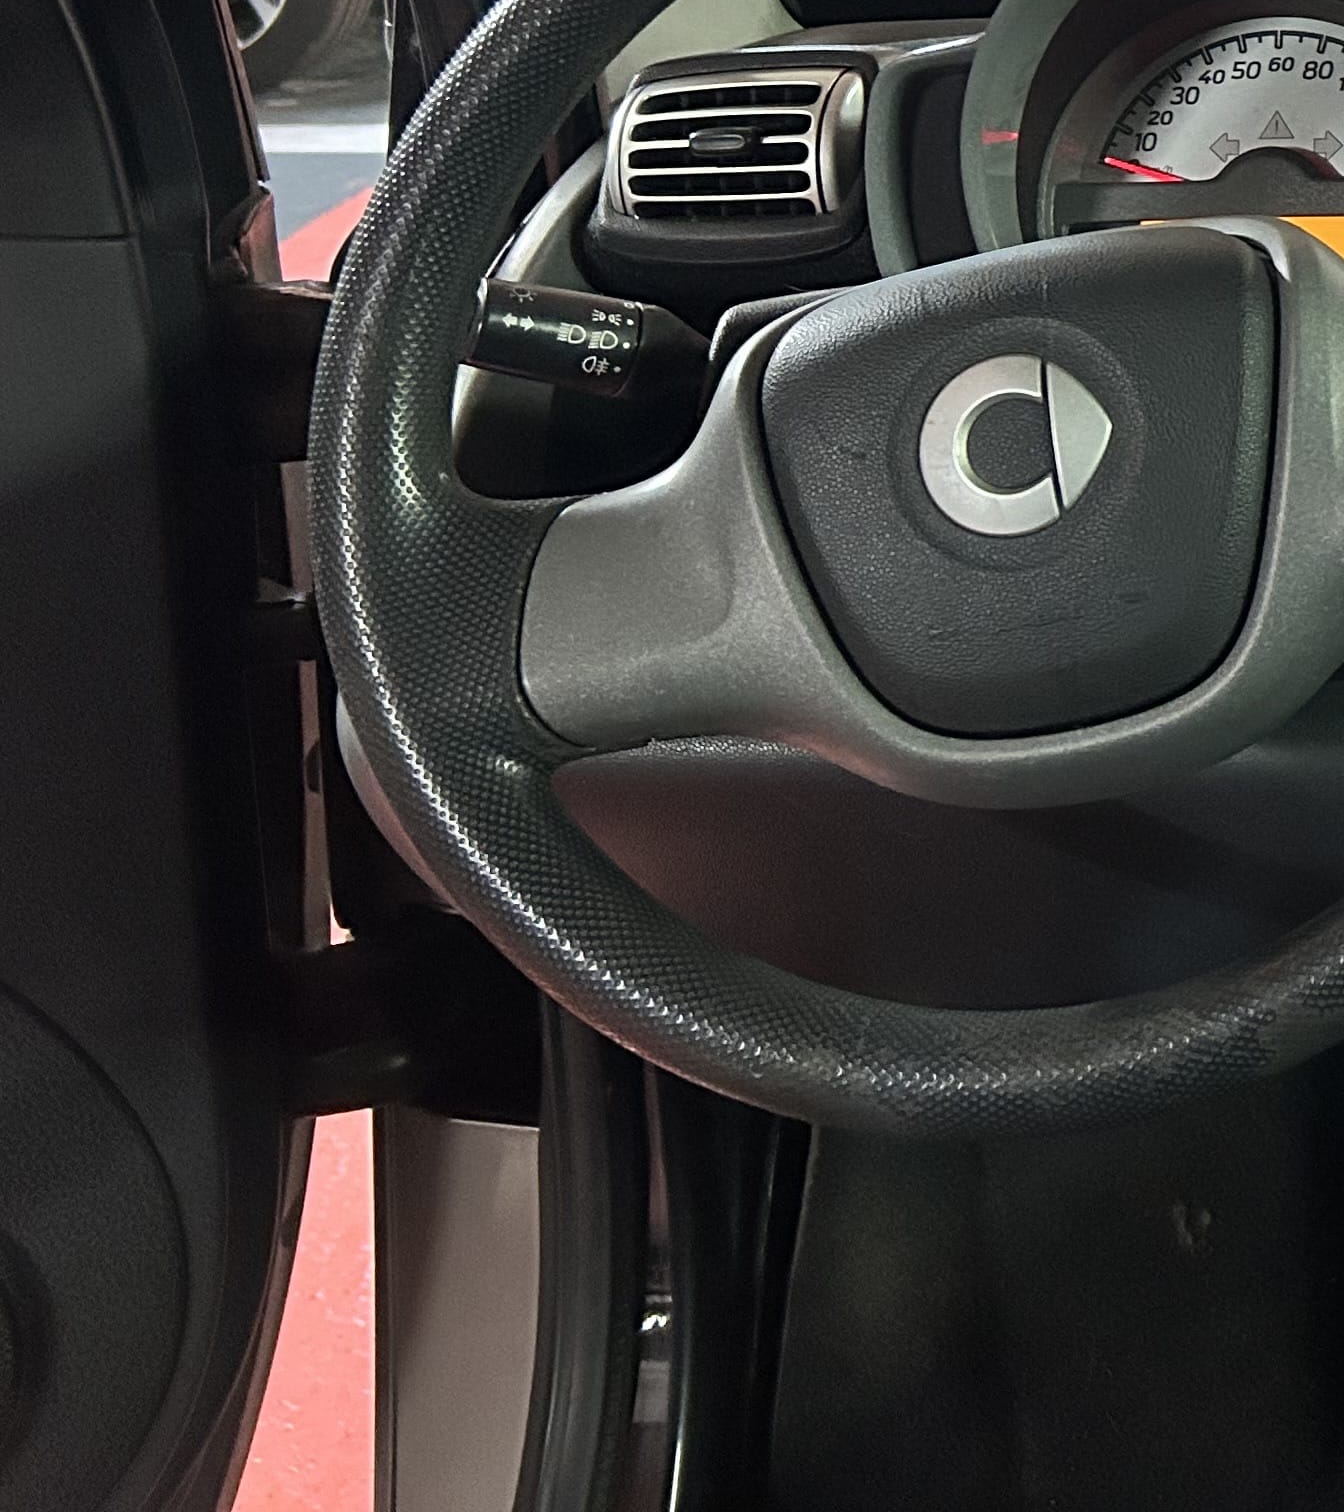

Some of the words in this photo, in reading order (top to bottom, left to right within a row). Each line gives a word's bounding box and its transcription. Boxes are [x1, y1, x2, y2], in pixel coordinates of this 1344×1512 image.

[1231, 61, 1262, 80] 50
[1268, 56, 1295, 72] 60
[1302, 60, 1334, 80] 80
[1198, 69, 1226, 85] 40
[1169, 86, 1200, 106] 30
[1147, 110, 1174, 126] 20
[1135, 132, 1158, 152] 10
